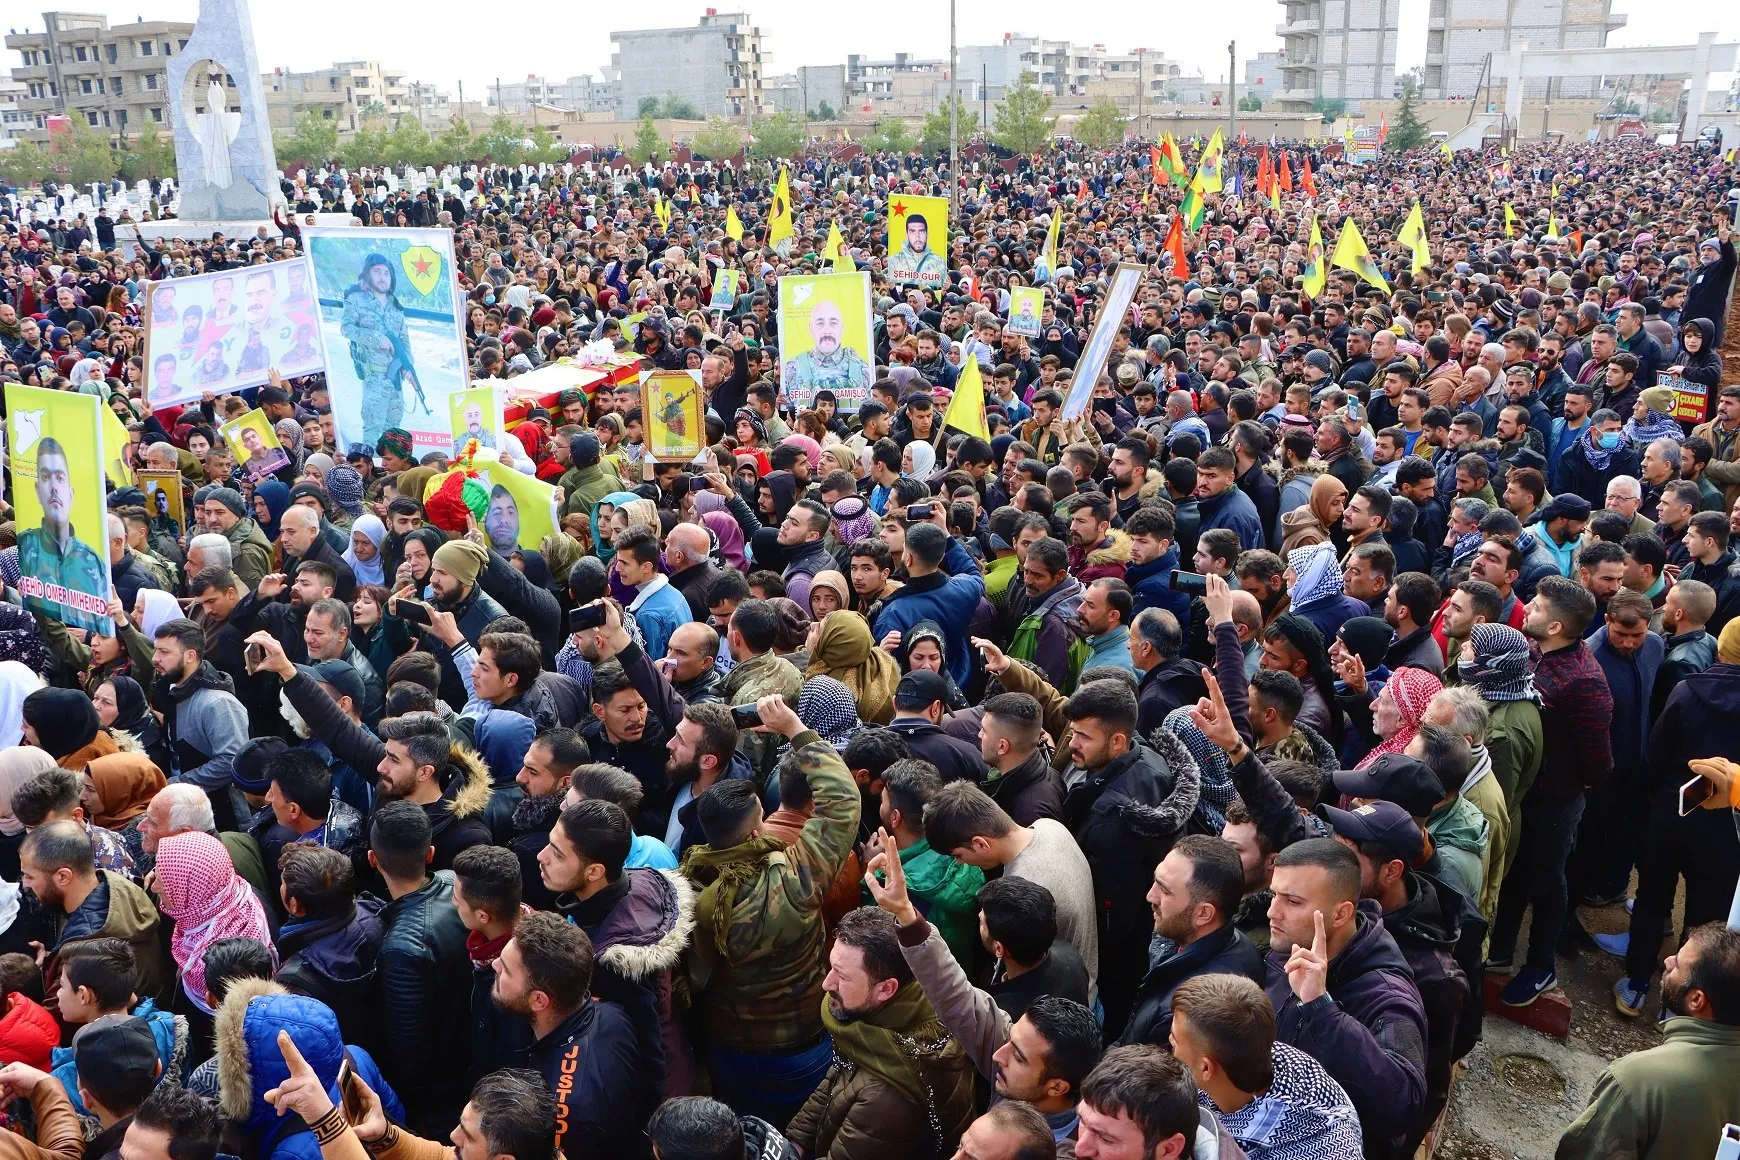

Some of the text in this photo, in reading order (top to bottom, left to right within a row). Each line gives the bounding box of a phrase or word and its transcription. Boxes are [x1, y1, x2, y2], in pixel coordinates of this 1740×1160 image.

[921, 272, 941, 281] GUR
[416, 433, 432, 443] Azad
[45, 583, 68, 605] OMER
[69, 590, 108, 616] MIHEMED
